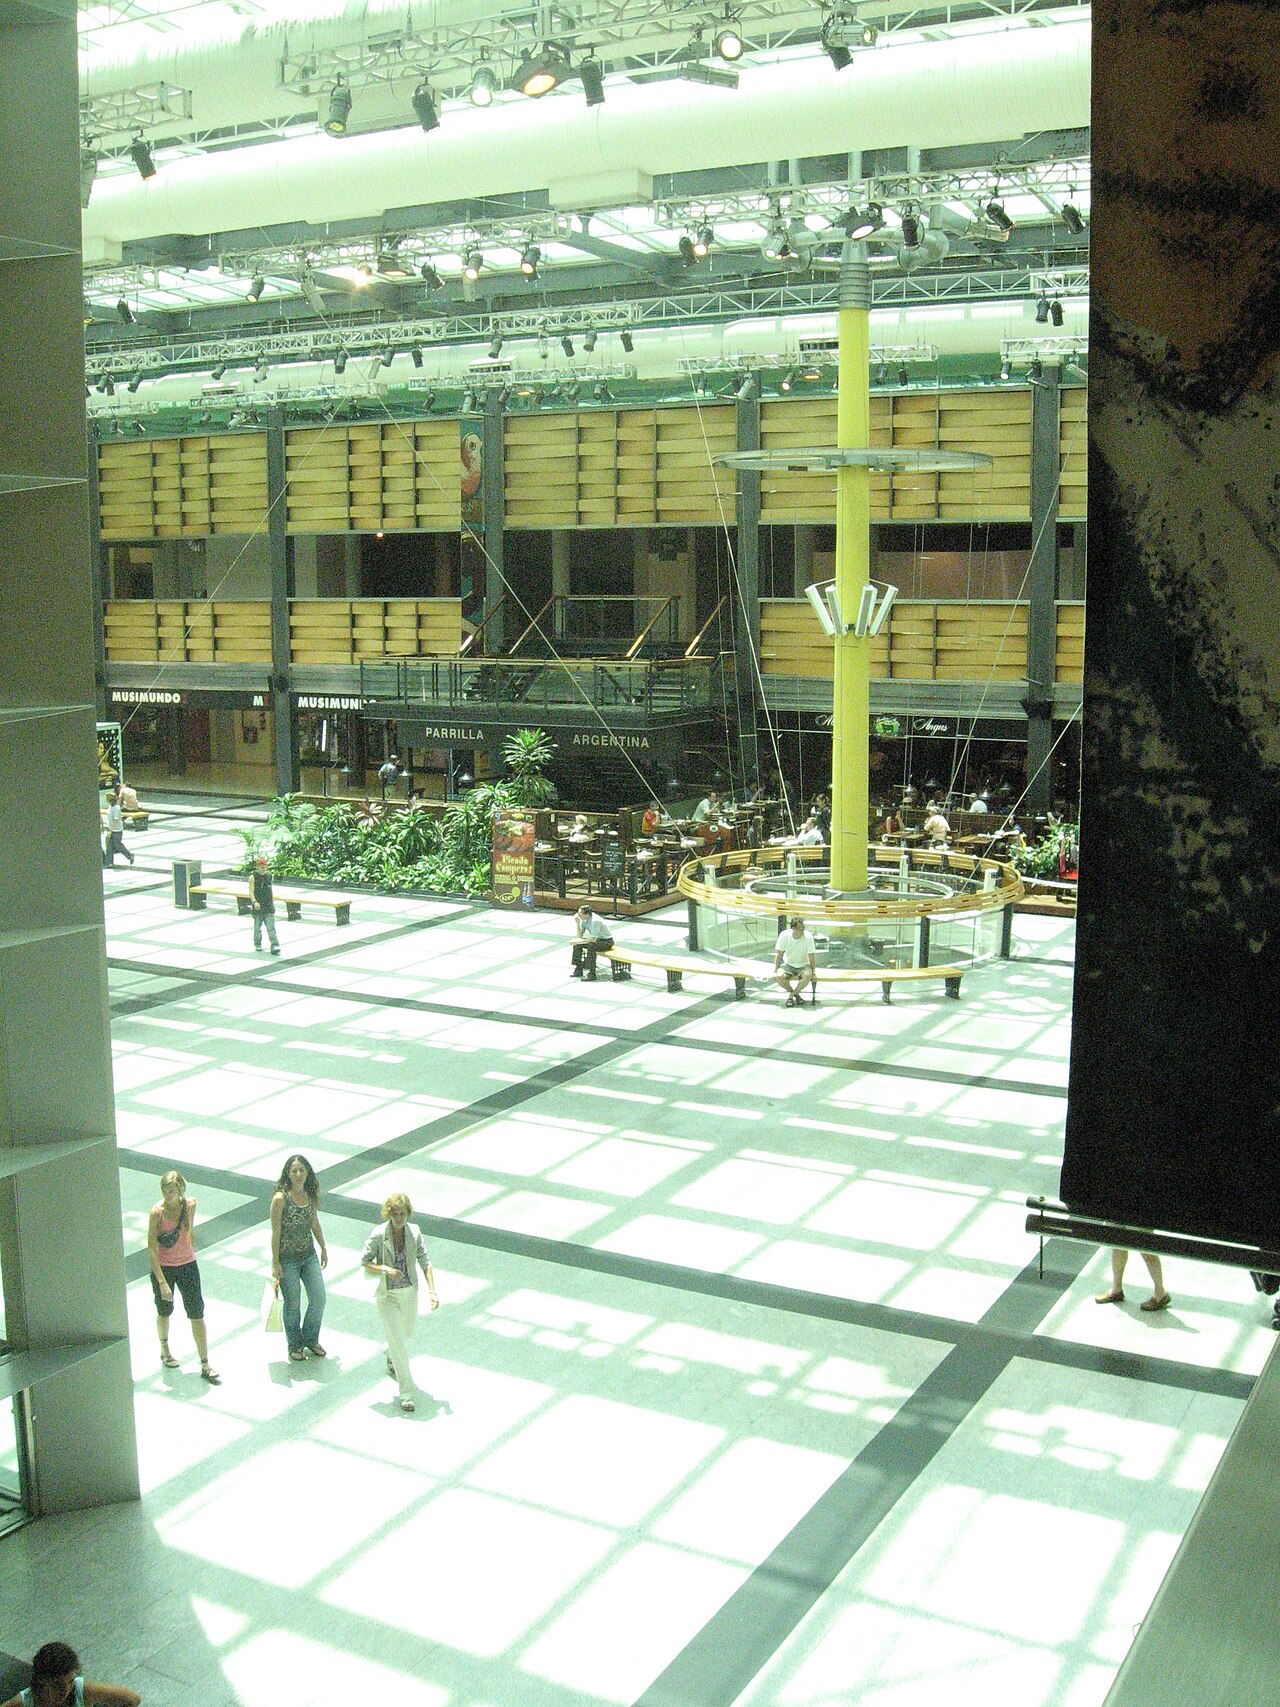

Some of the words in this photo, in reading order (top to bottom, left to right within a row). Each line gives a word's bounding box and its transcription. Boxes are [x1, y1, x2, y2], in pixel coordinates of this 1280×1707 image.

[112, 691, 181, 704] MUSIMUNDO
[912, 718, 948, 736] Angus
[425, 727, 484, 740] PARRILLA
[572, 733, 650, 748] ARGENTINA
